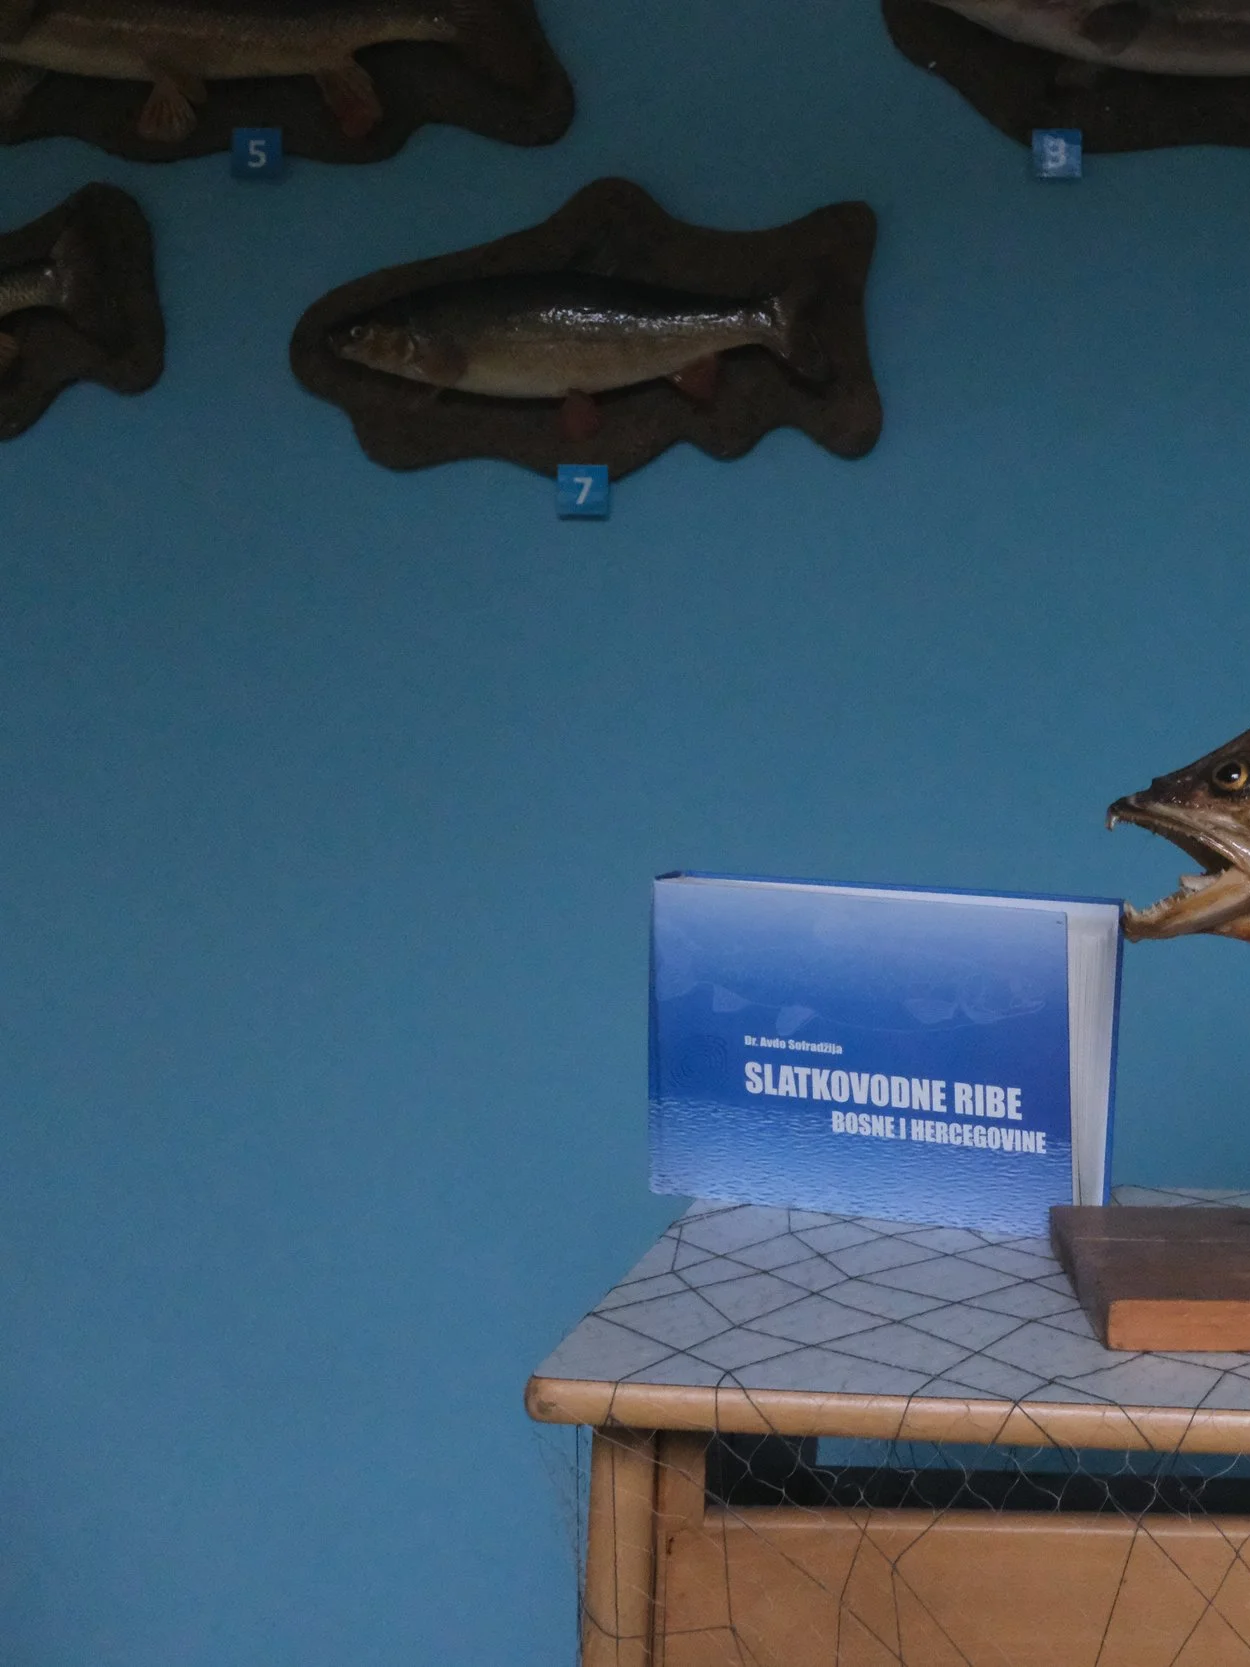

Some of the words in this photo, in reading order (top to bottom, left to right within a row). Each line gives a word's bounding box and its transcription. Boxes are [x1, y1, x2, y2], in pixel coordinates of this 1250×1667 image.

[248, 139, 267, 168] 5
[573, 476, 593, 505] 7
[744, 1035, 759, 1046] Dr.
[760, 1036, 786, 1049] Avdo
[788, 1039, 843, 1055] Sofradžija
[744, 1061, 947, 1113] SLATKOVODNE
[954, 1081, 1022, 1120] RIBE
[831, 1110, 895, 1139] BOSNE
[899, 1117, 907, 1140] I
[910, 1118, 1047, 1154] HERCEGOVINE
